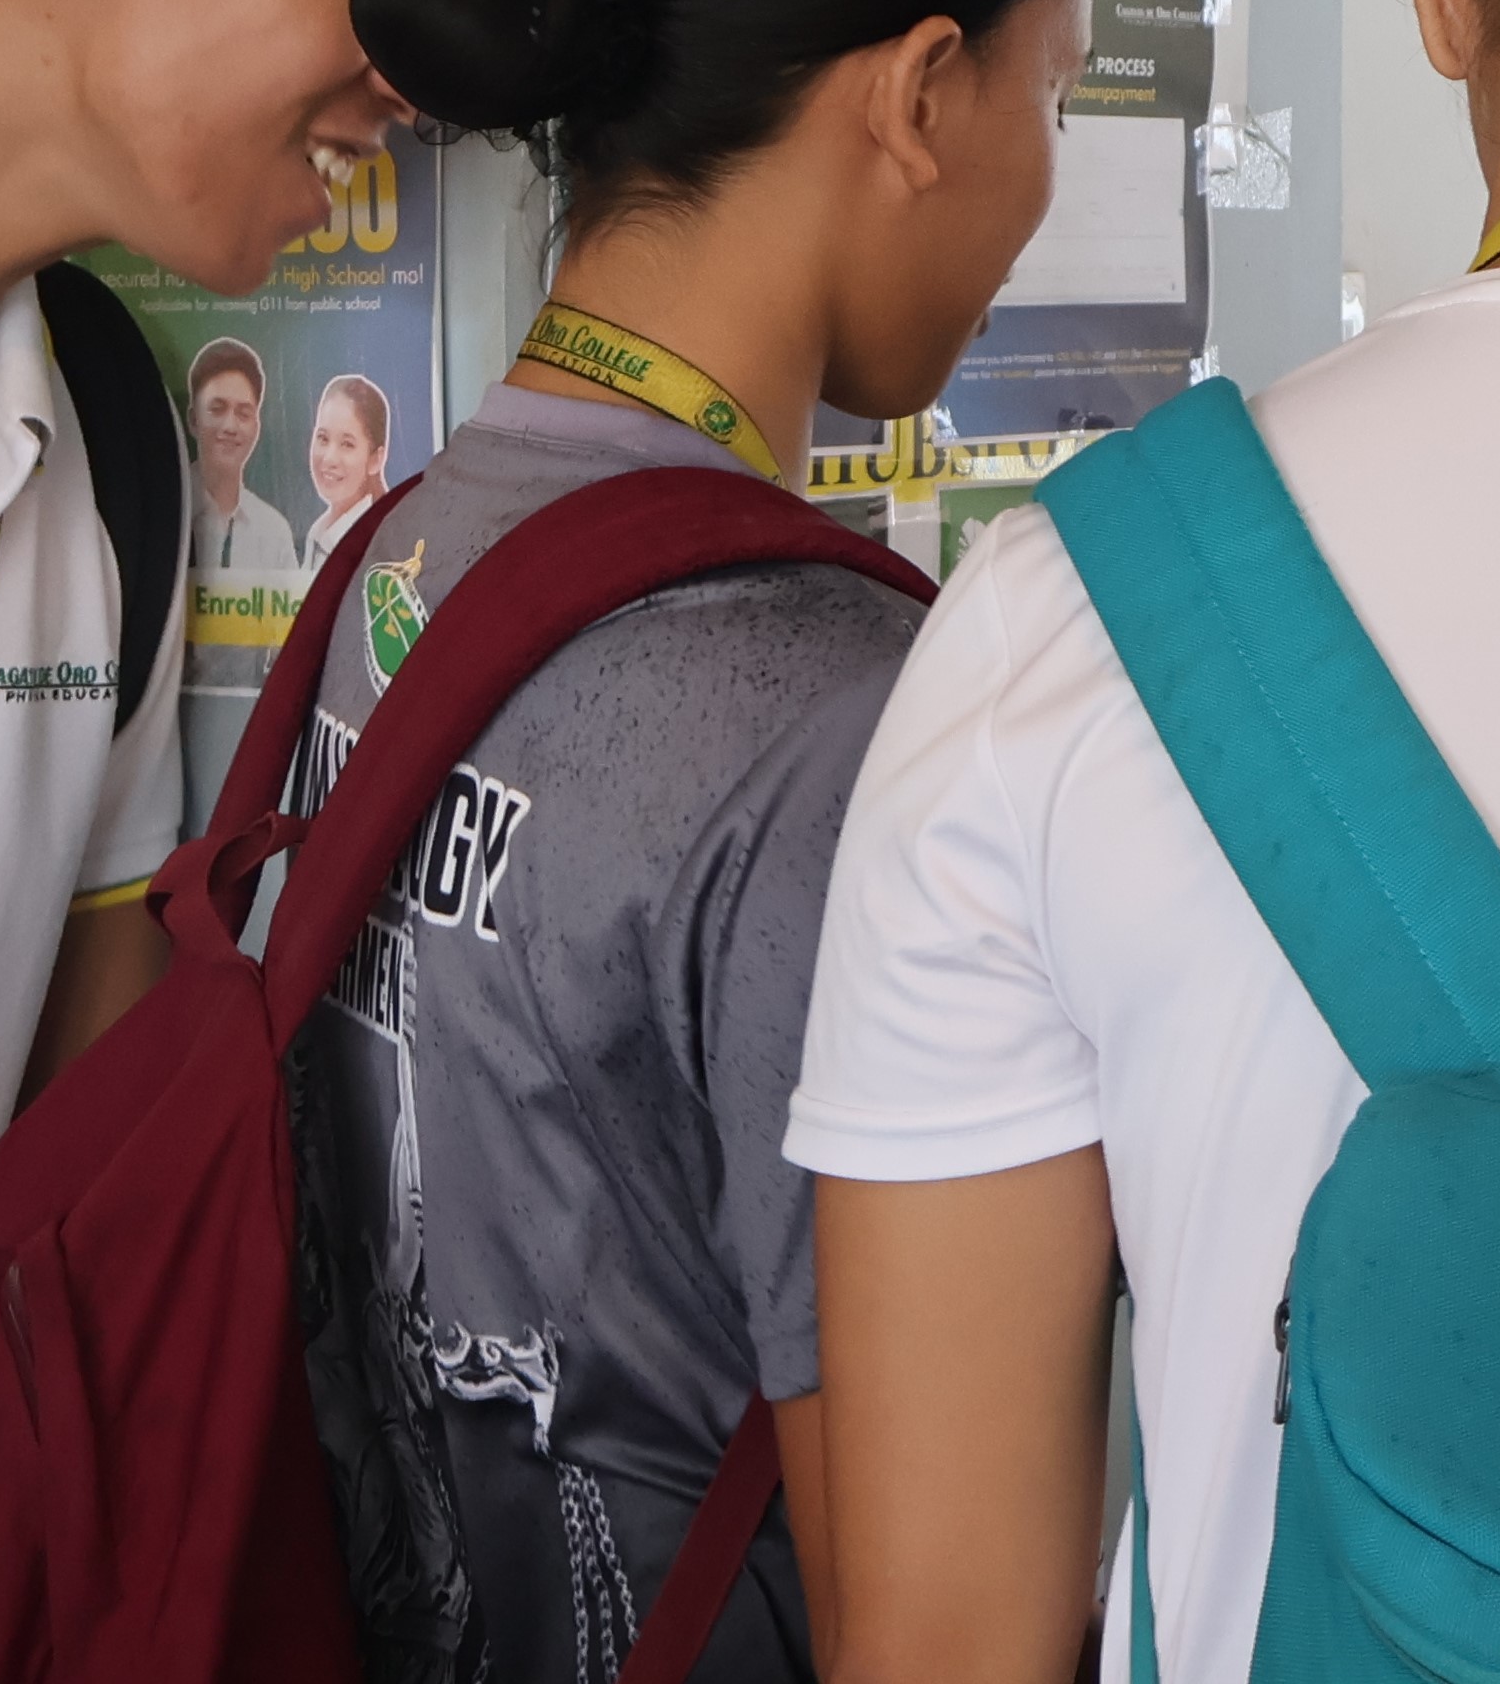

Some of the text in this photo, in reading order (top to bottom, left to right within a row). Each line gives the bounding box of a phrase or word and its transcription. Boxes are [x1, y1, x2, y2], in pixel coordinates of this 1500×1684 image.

[1096, 56, 1155, 77] PROCESS
[100, 266, 159, 289] secured
[283, 266, 320, 292] High
[327, 263, 386, 287] School
[309, 296, 343, 314] public
[345, 295, 381, 311] school
[570, 325, 654, 376] COLLEGE
[195, 586, 303, 617] Enroll No
[57, 661, 97, 686] ORO
[52, 687, 114, 701] EDUCA
